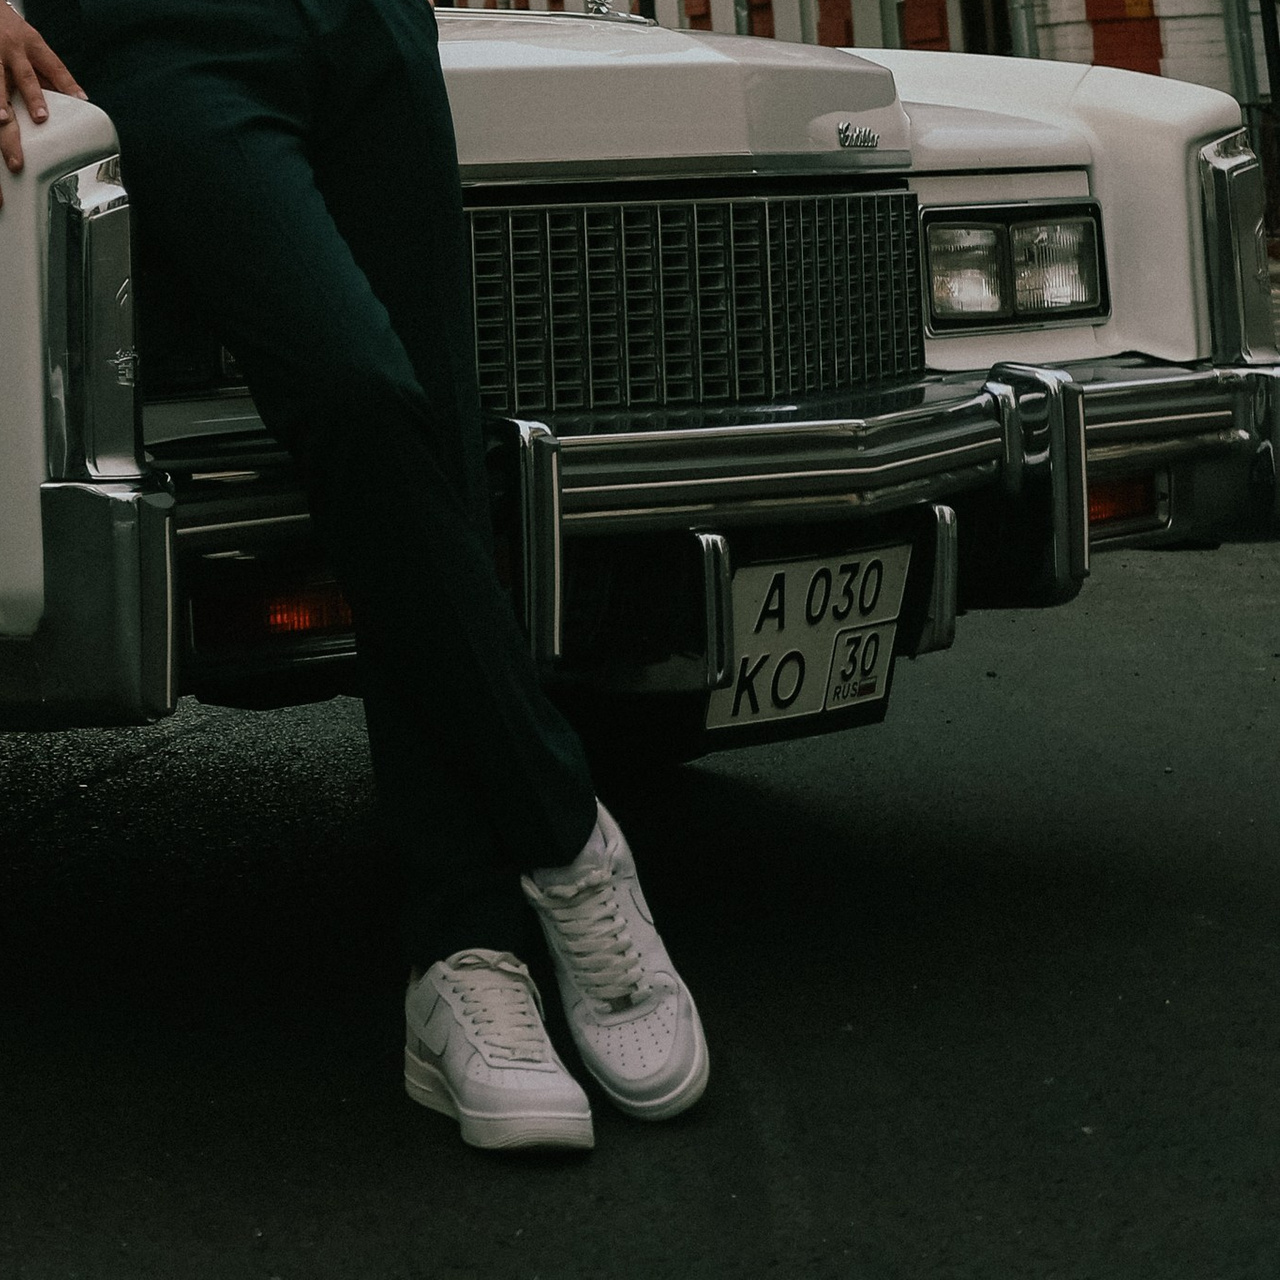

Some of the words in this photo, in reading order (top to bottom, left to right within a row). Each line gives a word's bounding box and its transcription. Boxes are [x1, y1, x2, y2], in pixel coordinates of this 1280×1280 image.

[753, 571, 786, 634] А
[805, 559, 884, 626] 030
[841, 632, 880, 681] 30
[832, 683, 858, 701] RUS
